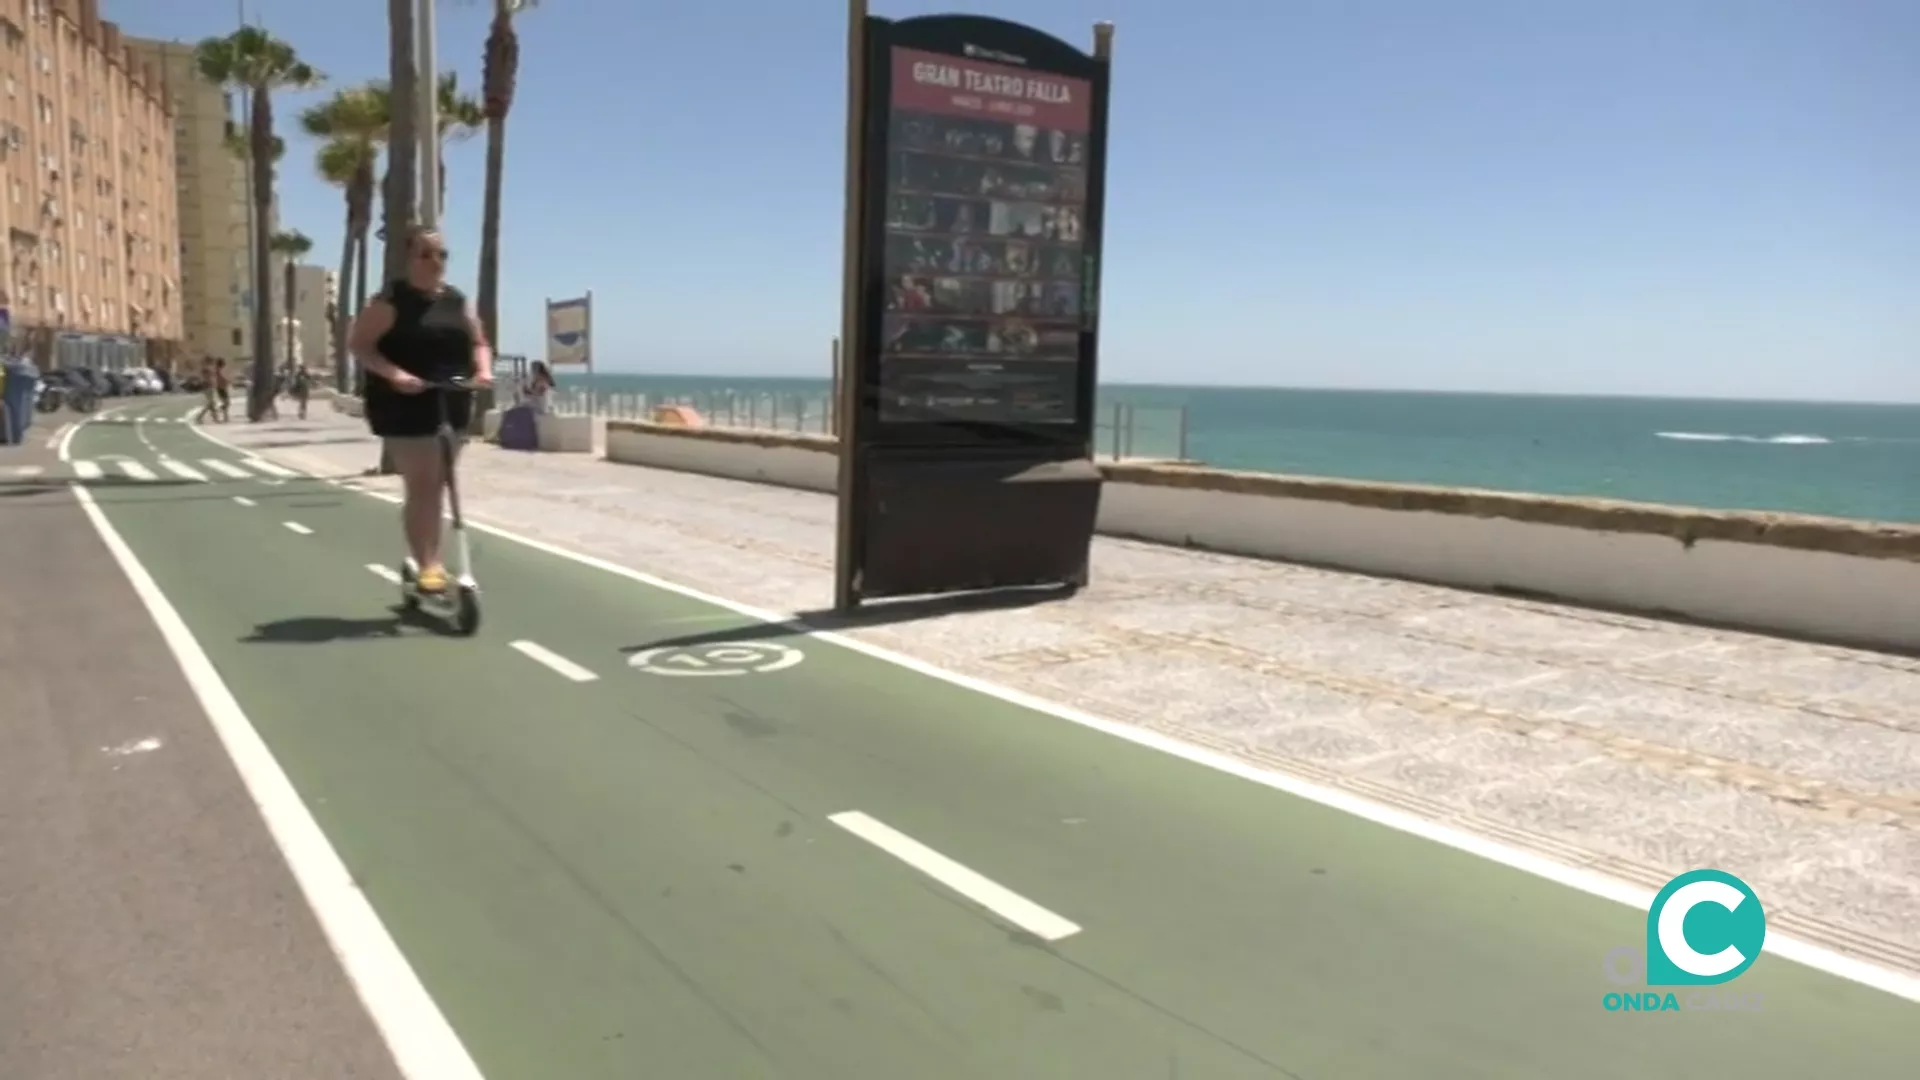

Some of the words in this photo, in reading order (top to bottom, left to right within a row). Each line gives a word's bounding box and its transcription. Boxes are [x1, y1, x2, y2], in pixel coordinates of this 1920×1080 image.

[912, 62, 960, 87] GRAN
[964, 69, 1024, 97] TEATRO
[1027, 80, 1071, 103] FALLA
[666, 648, 765, 667] 10
